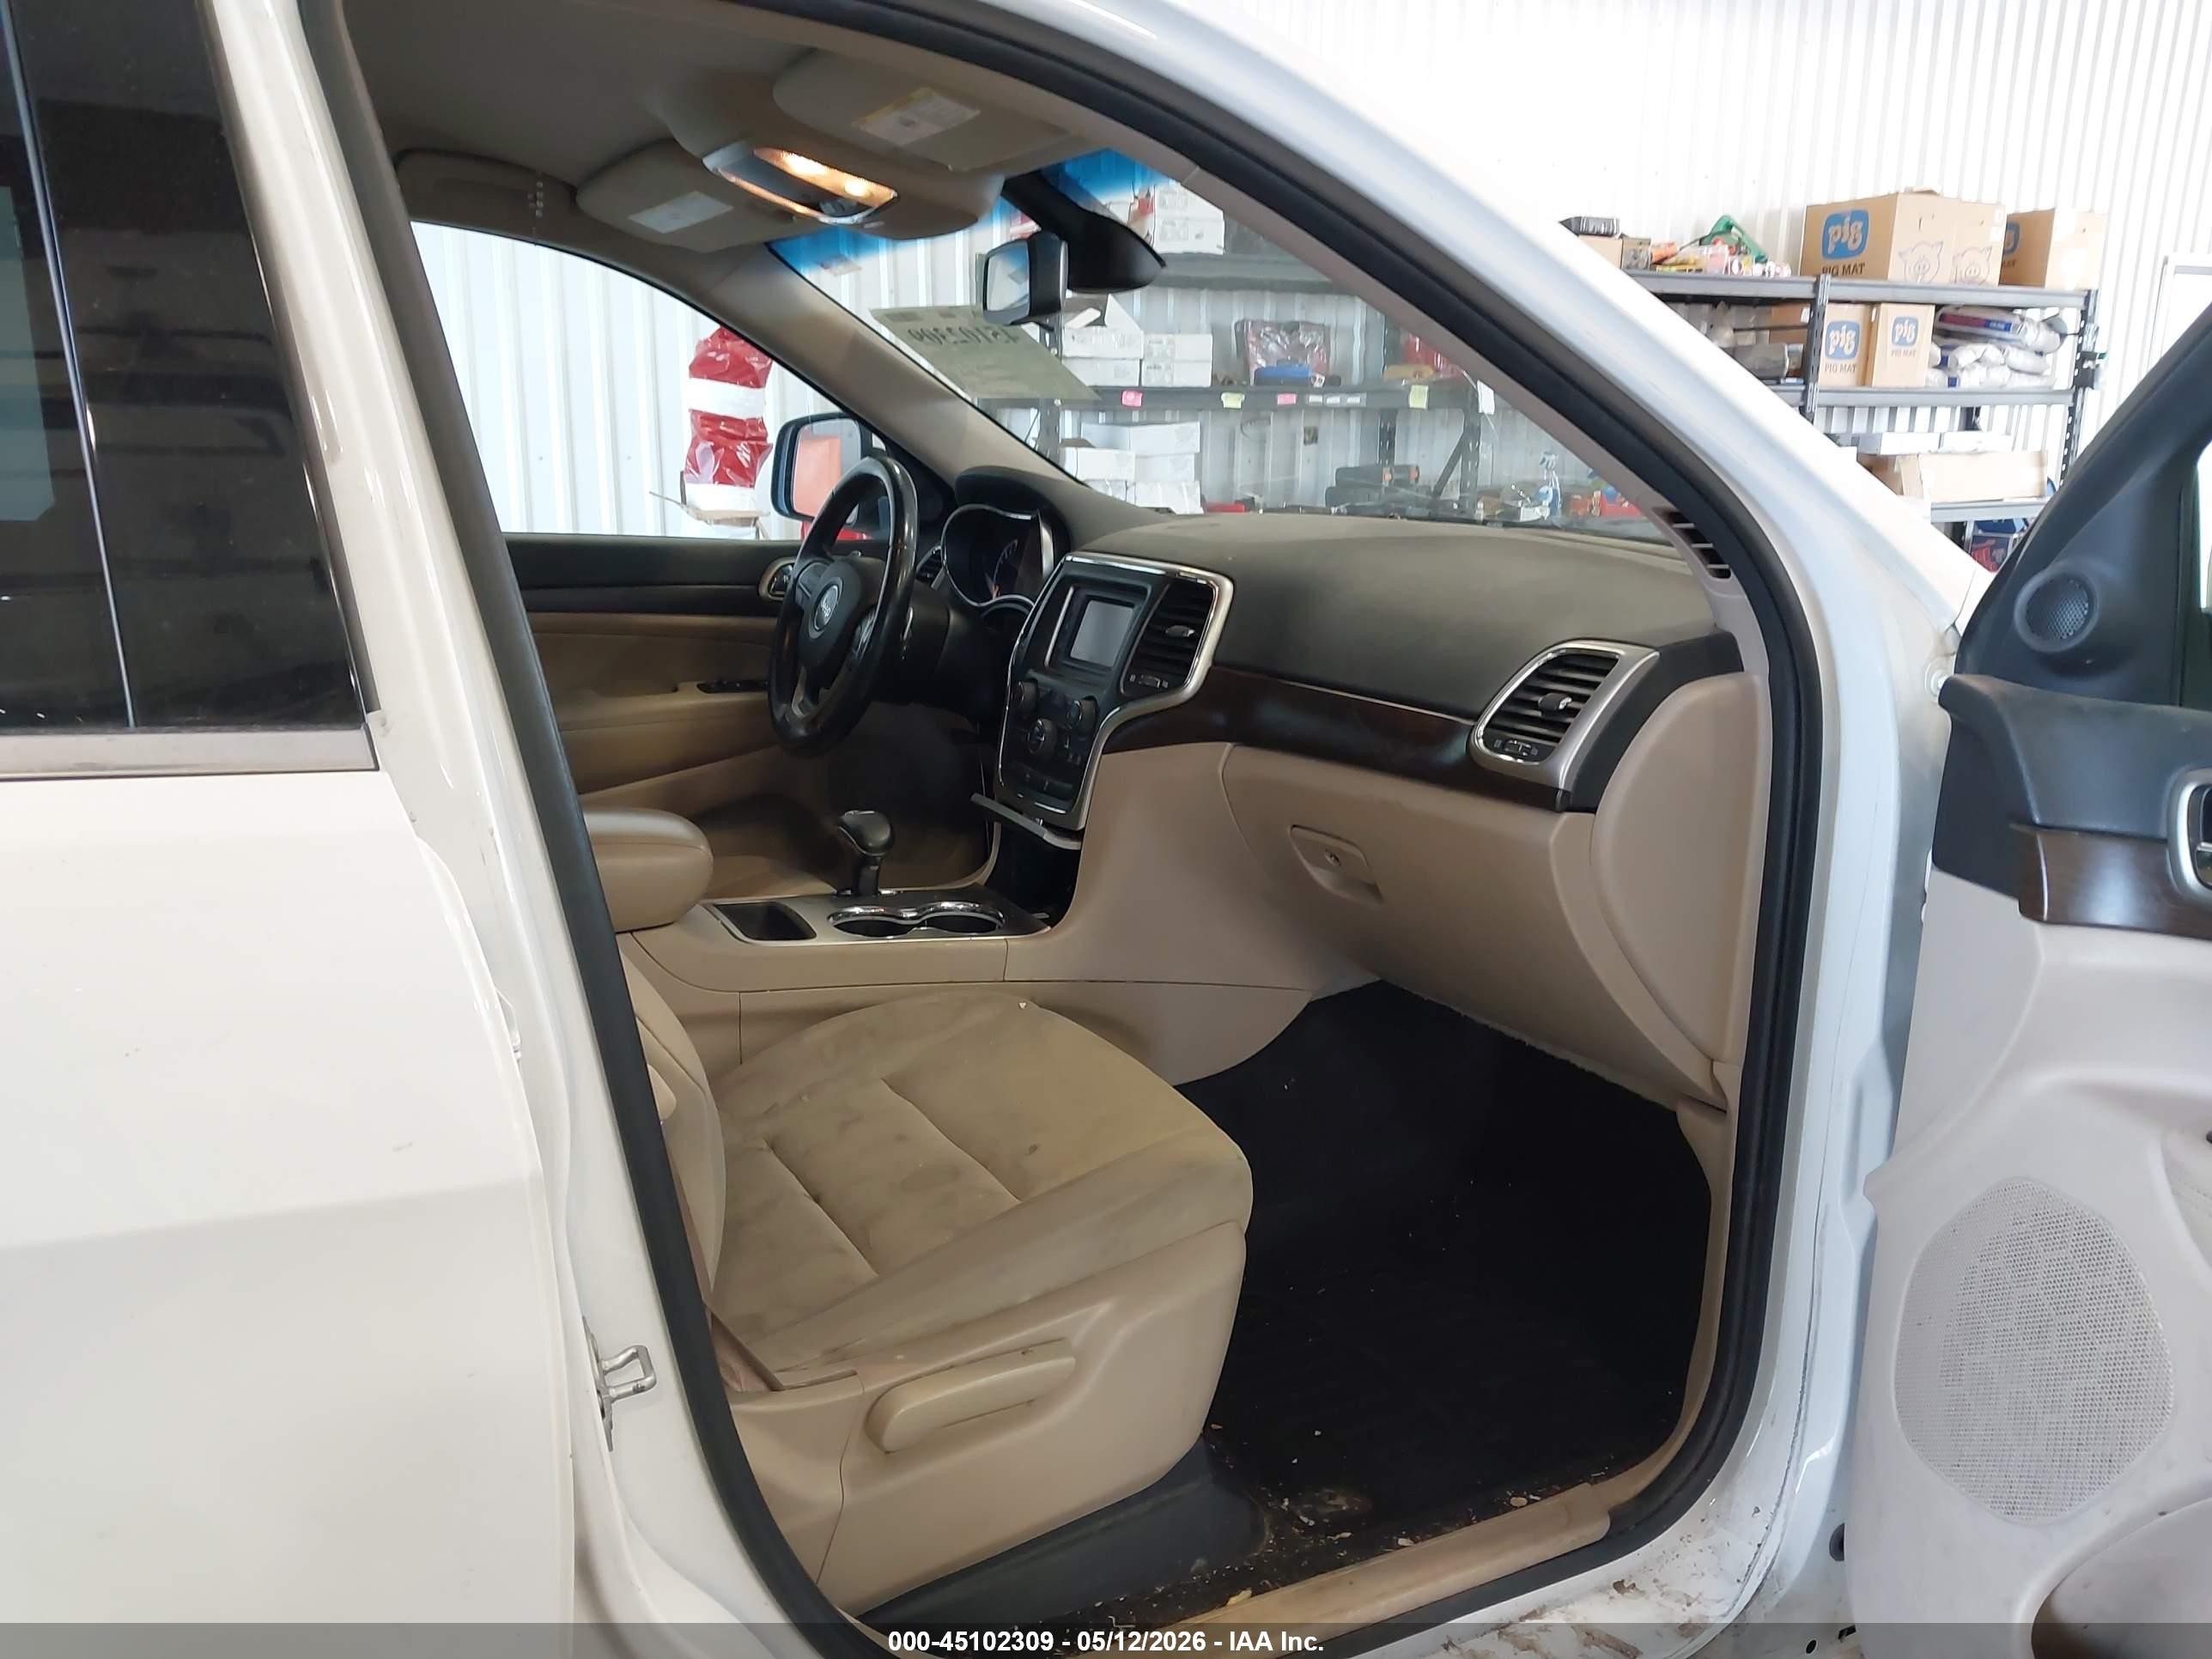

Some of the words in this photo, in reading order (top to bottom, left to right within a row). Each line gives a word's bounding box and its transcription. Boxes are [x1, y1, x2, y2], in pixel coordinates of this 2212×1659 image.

[1827, 215, 1863, 255] pig
[1842, 262, 1866, 276] MAT
[1828, 323, 1856, 356] pig
[1894, 319, 1917, 343] pig
[1839, 363, 1856, 373] MAT
